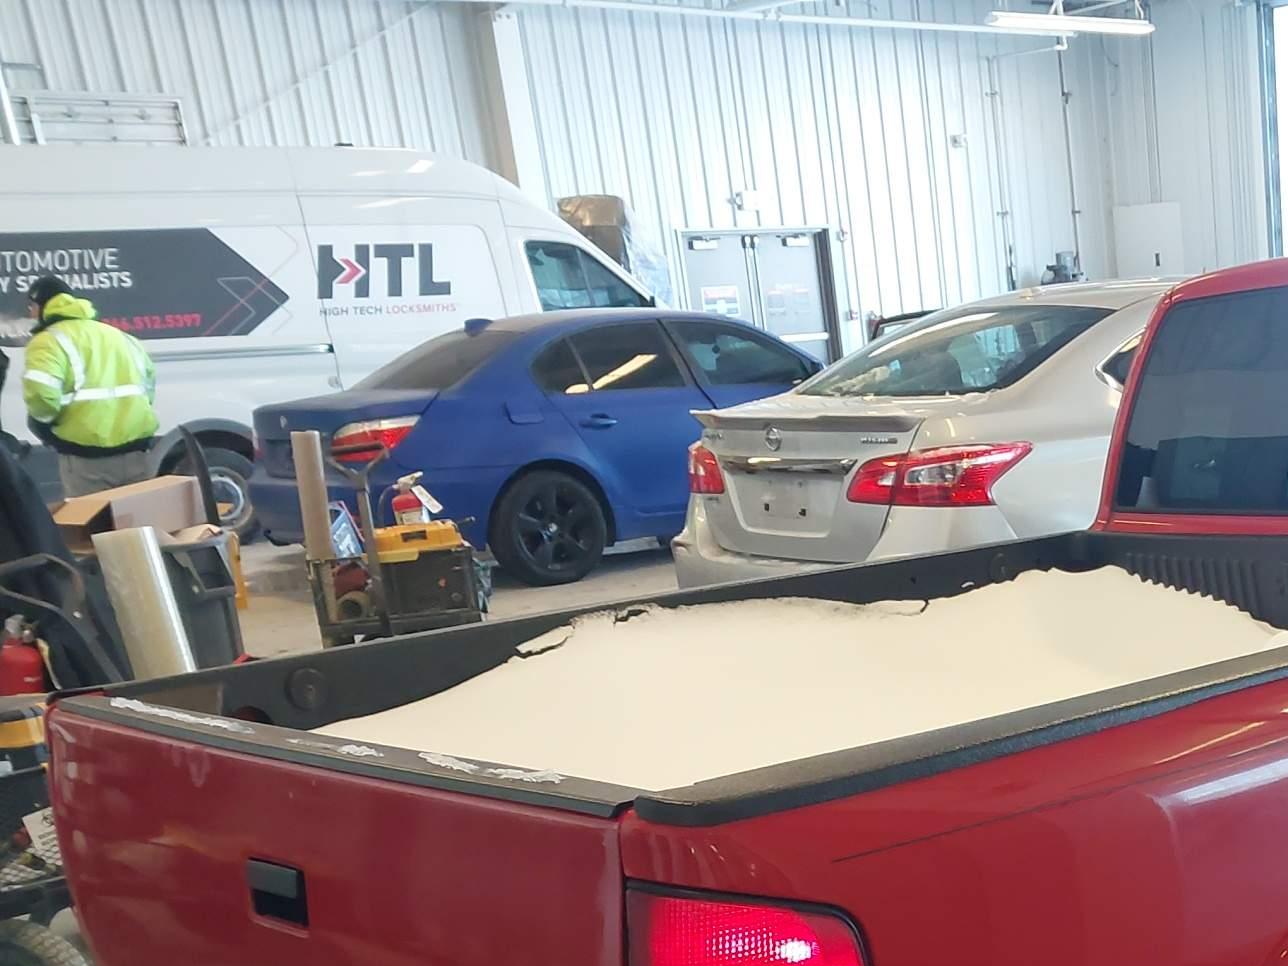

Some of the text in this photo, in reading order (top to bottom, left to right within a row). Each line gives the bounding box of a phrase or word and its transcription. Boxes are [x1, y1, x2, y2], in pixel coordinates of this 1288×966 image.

[0, 248, 119, 272] TOMOTIVE
[317, 243, 451, 299] HTL
[320, 303, 457, 316] HIGH TECH LOCKSMITHS
